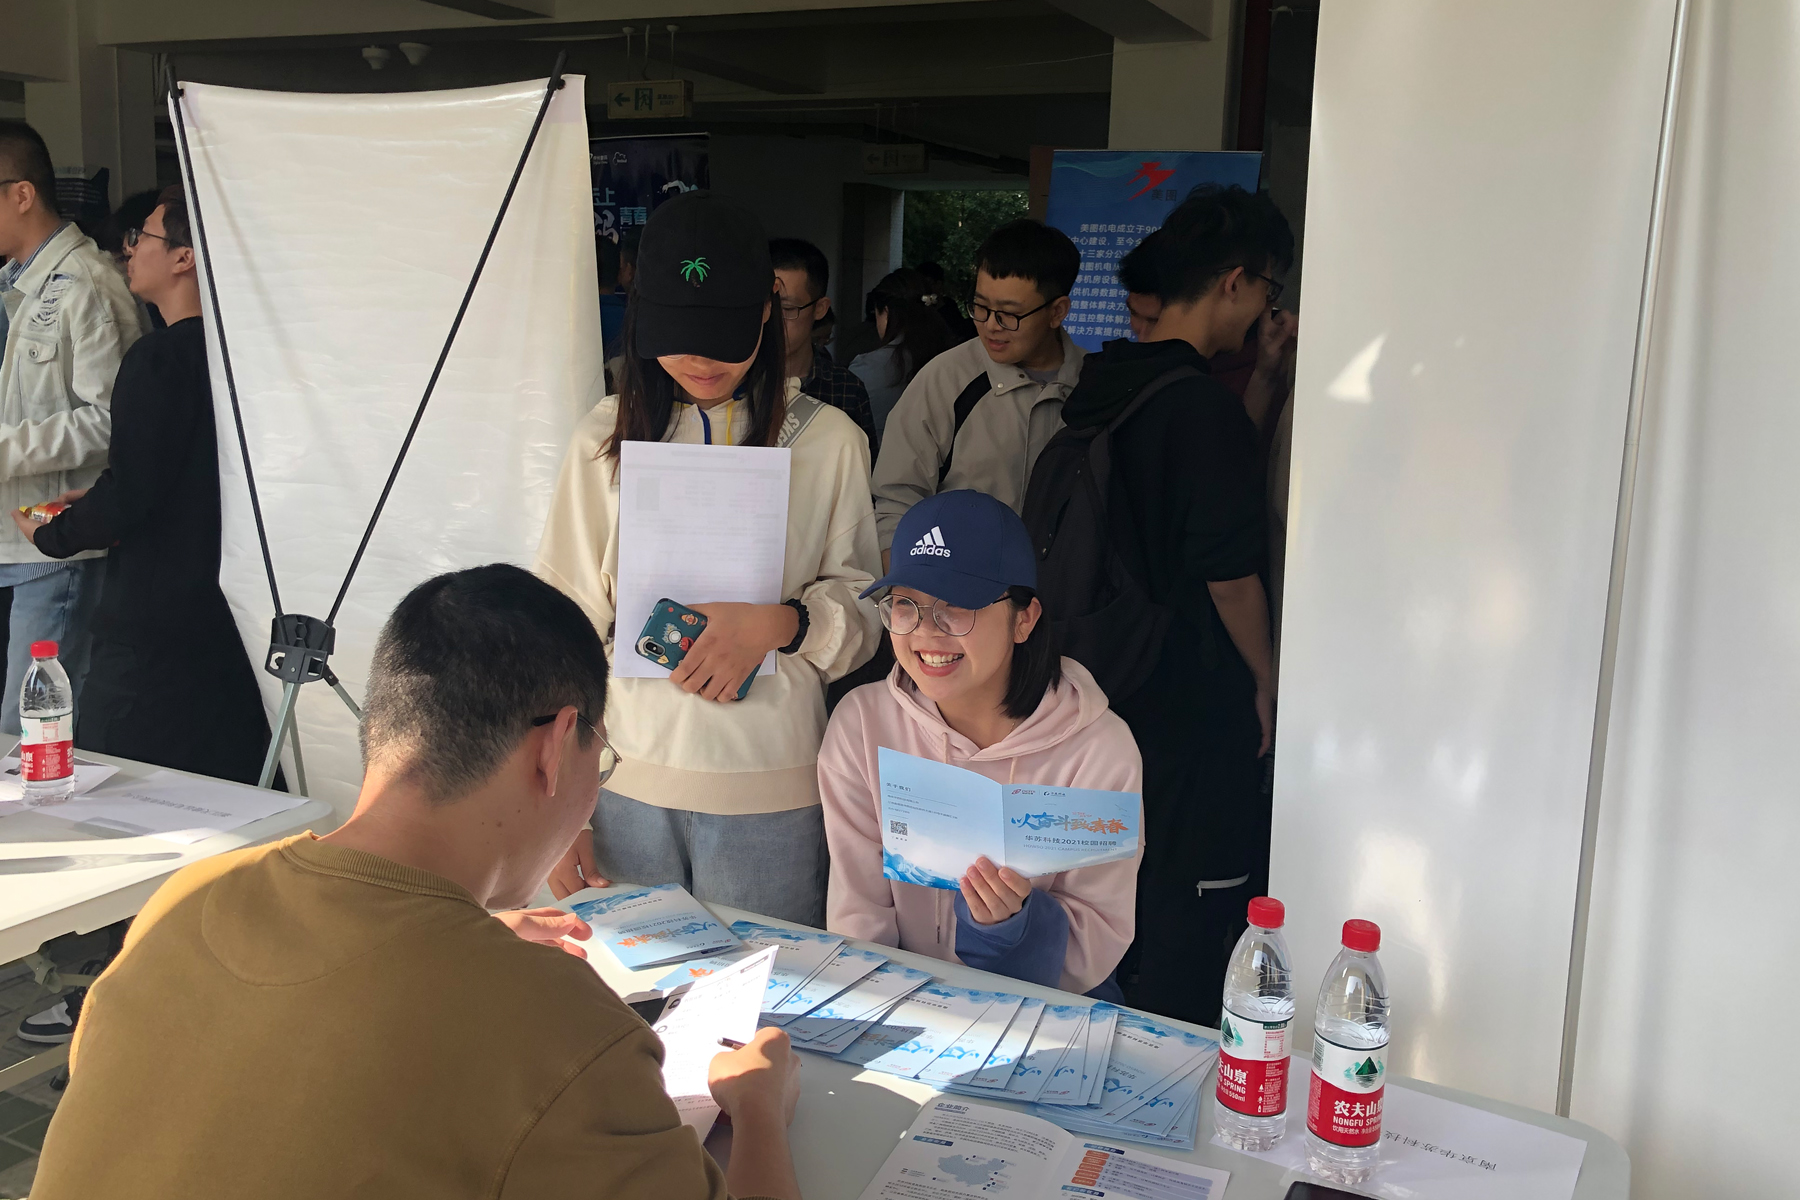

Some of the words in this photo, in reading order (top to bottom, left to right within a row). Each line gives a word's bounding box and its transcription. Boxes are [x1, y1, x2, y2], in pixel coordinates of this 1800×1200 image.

[1070, 287, 1130, 299] 供机房数据中
[1071, 299, 1131, 312] 信整体解决方
[910, 544, 951, 558] adidas
[1011, 811, 1129, 835] 以奋斗致青春
[1025, 834, 1117, 847] 华苏科技2021校园招聘
[1223, 1078, 1247, 1095] SPRING
[937, 1102, 969, 1112] 企业简介
[1333, 1115, 1364, 1128] NONGFU
